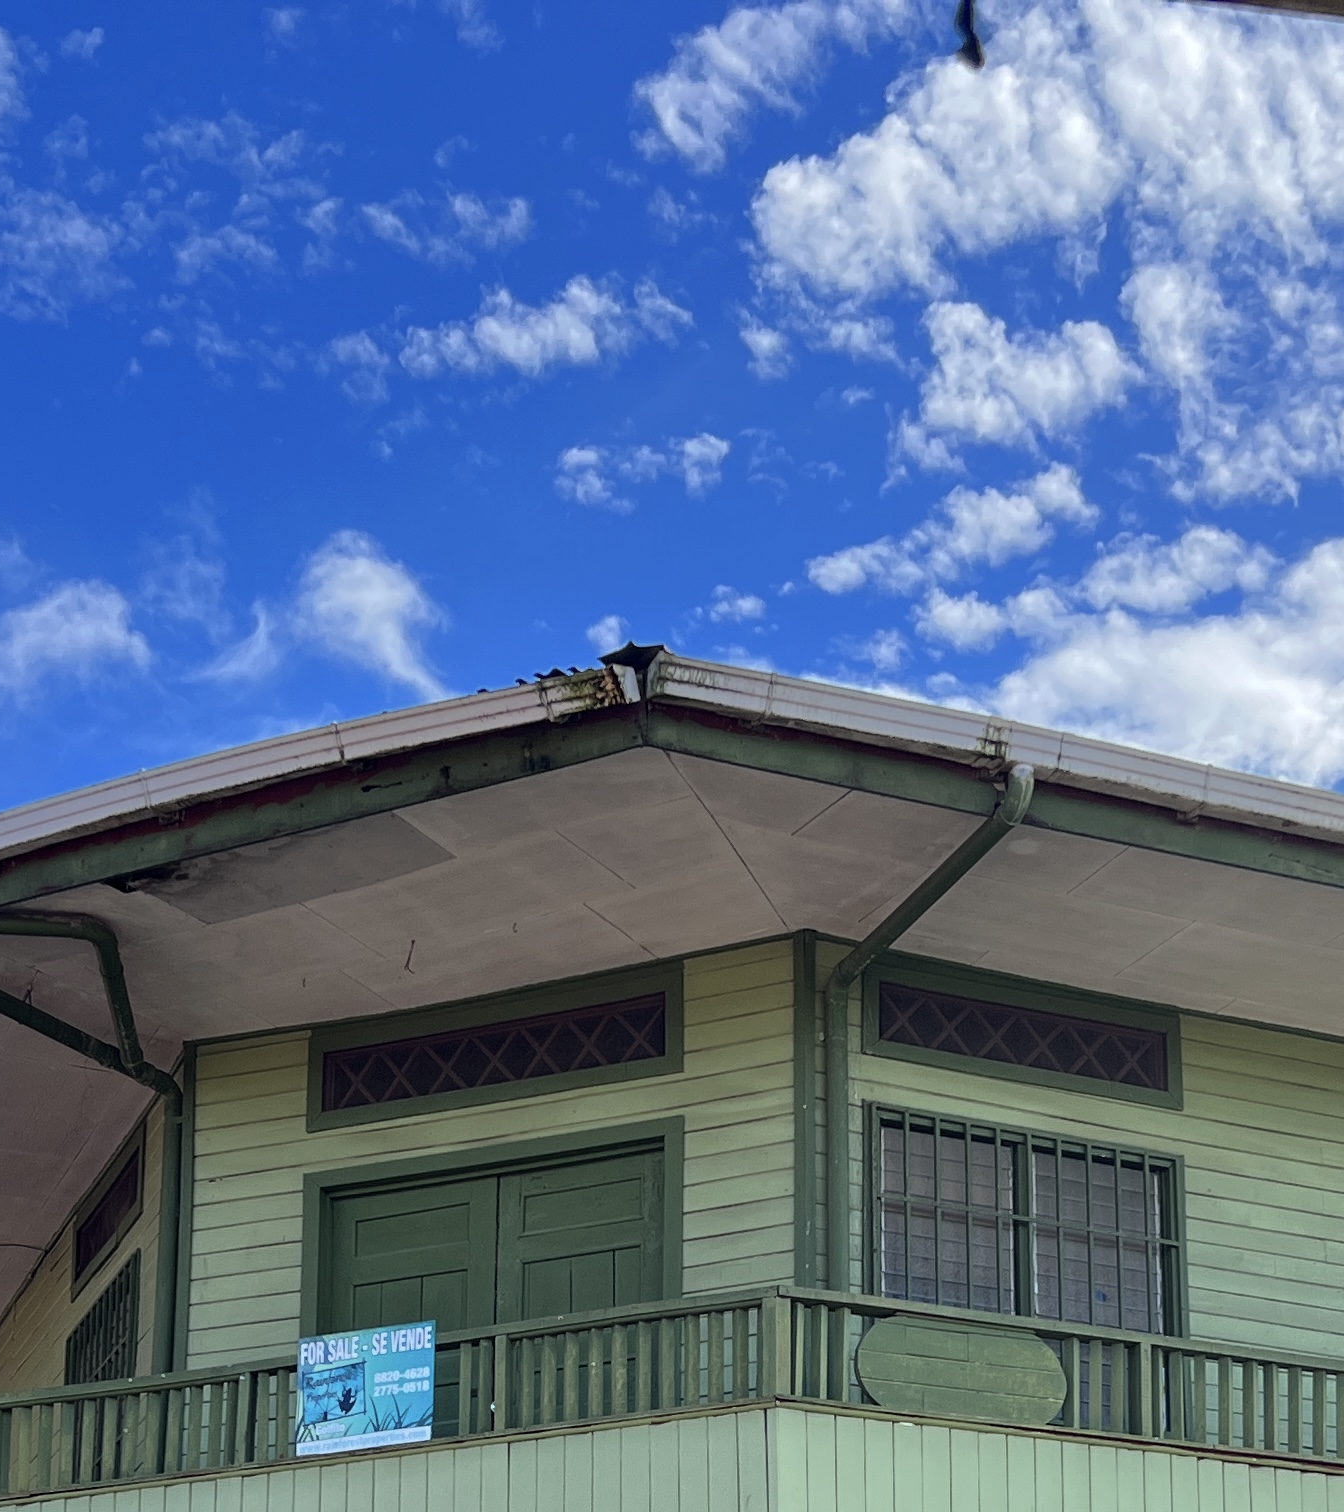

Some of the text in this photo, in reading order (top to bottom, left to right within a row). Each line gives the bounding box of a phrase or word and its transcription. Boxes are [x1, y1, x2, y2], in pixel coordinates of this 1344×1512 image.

[300, 1342, 325, 1366] FOR
[328, 1336, 359, 1362] SALE
[371, 1332, 388, 1355] SE
[390, 1326, 432, 1353] VENDE
[315, 1423, 346, 1436] Golfito
